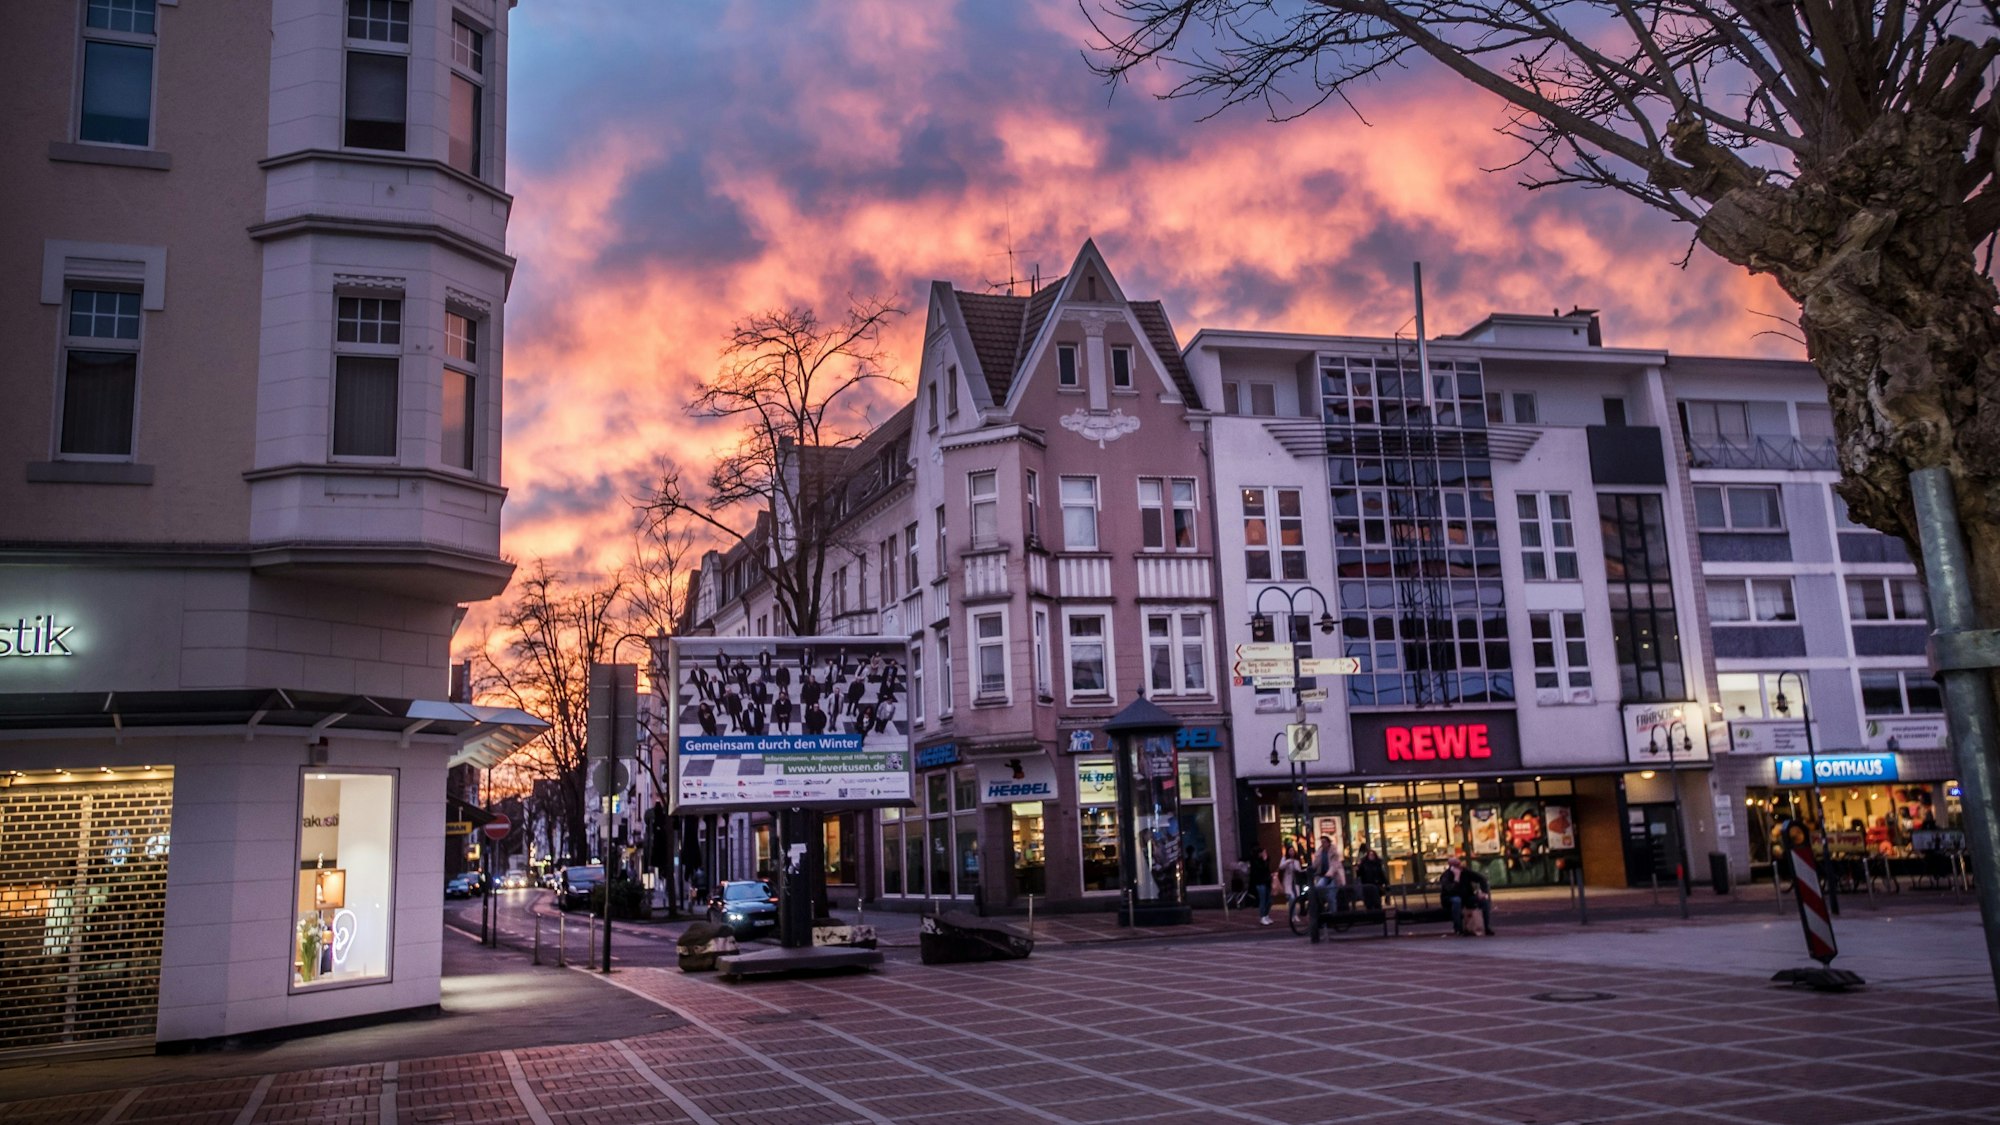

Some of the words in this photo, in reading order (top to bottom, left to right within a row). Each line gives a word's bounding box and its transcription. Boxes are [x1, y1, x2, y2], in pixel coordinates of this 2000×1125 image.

[684, 740, 755, 751] Gemeinsam
[757, 739, 791, 750] durch
[793, 739, 816, 749] den
[819, 738, 859, 749] Winter
[1385, 724, 1492, 761] REWE
[787, 762, 886, 773] www.leverkusen.de
[988, 782, 1051, 797] HEBBEL
